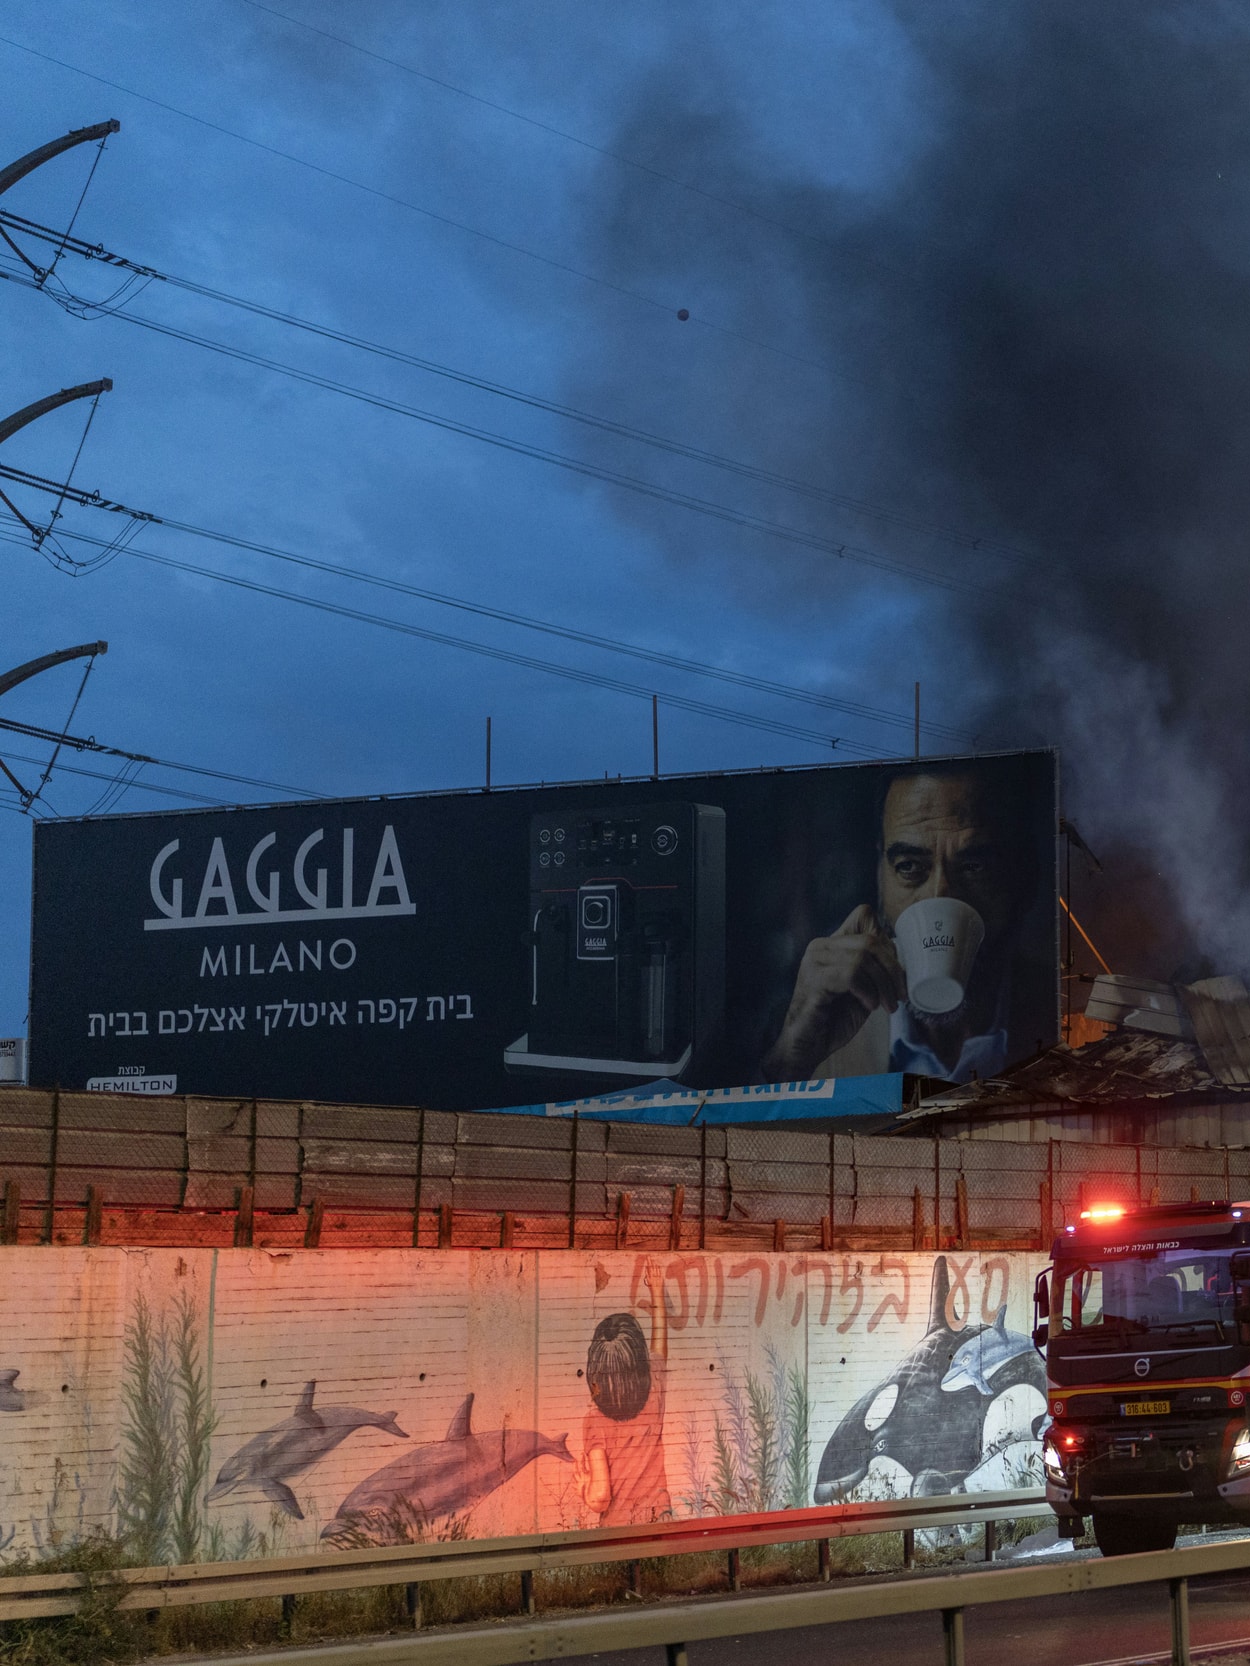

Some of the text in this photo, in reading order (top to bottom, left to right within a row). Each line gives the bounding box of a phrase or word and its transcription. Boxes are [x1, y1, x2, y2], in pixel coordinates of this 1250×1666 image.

[145, 825, 416, 930] GAGGIA
[923, 935, 955, 949] GAGGIA
[200, 938, 356, 977] MILANO
[88, 994, 473, 1037] בית קפה איטלקי אצלכם בבית
[118, 1065, 146, 1076] קבוצת
[90, 1080, 173, 1092] HEMILTON
[1103, 1241, 1180, 1254] כבאות והצלה לישראל
[944, 1256, 1010, 1331] סע
